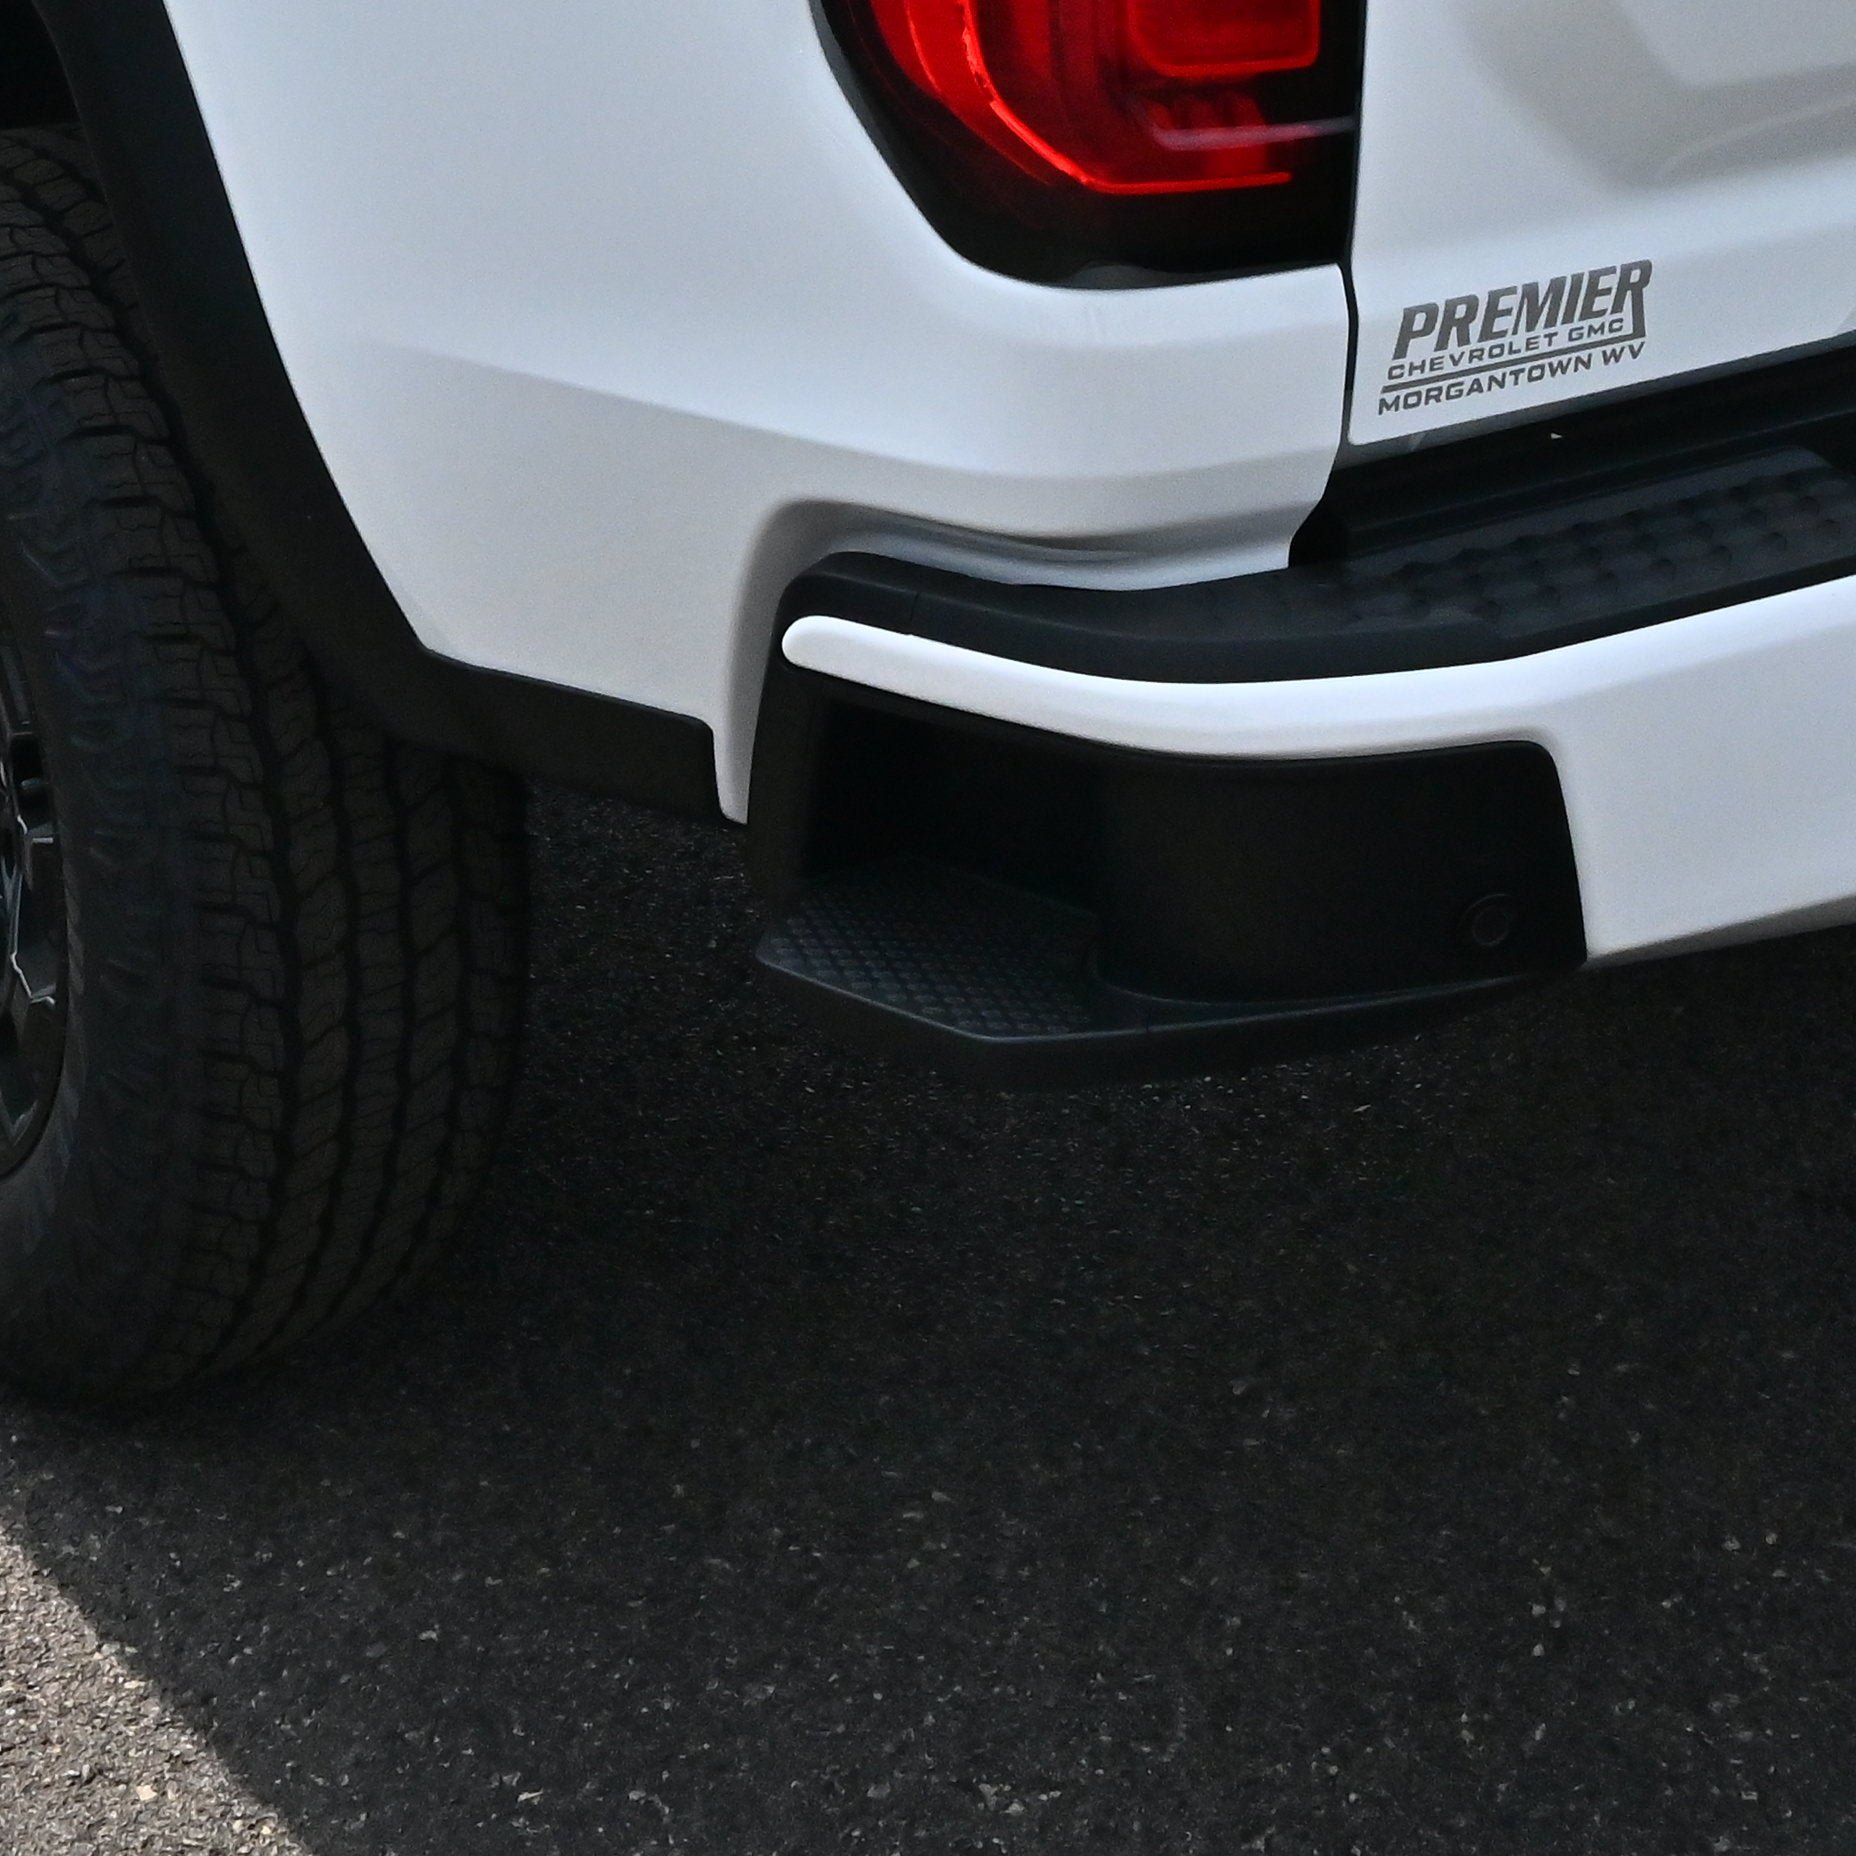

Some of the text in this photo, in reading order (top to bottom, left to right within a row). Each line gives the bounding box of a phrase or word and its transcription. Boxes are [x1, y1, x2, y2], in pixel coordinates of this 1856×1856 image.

[1392, 259, 1653, 360] PREMIER
[1377, 341, 1646, 416] MORGANTOWN WV
[1387, 317, 1624, 380] CHEVROLET GMC
